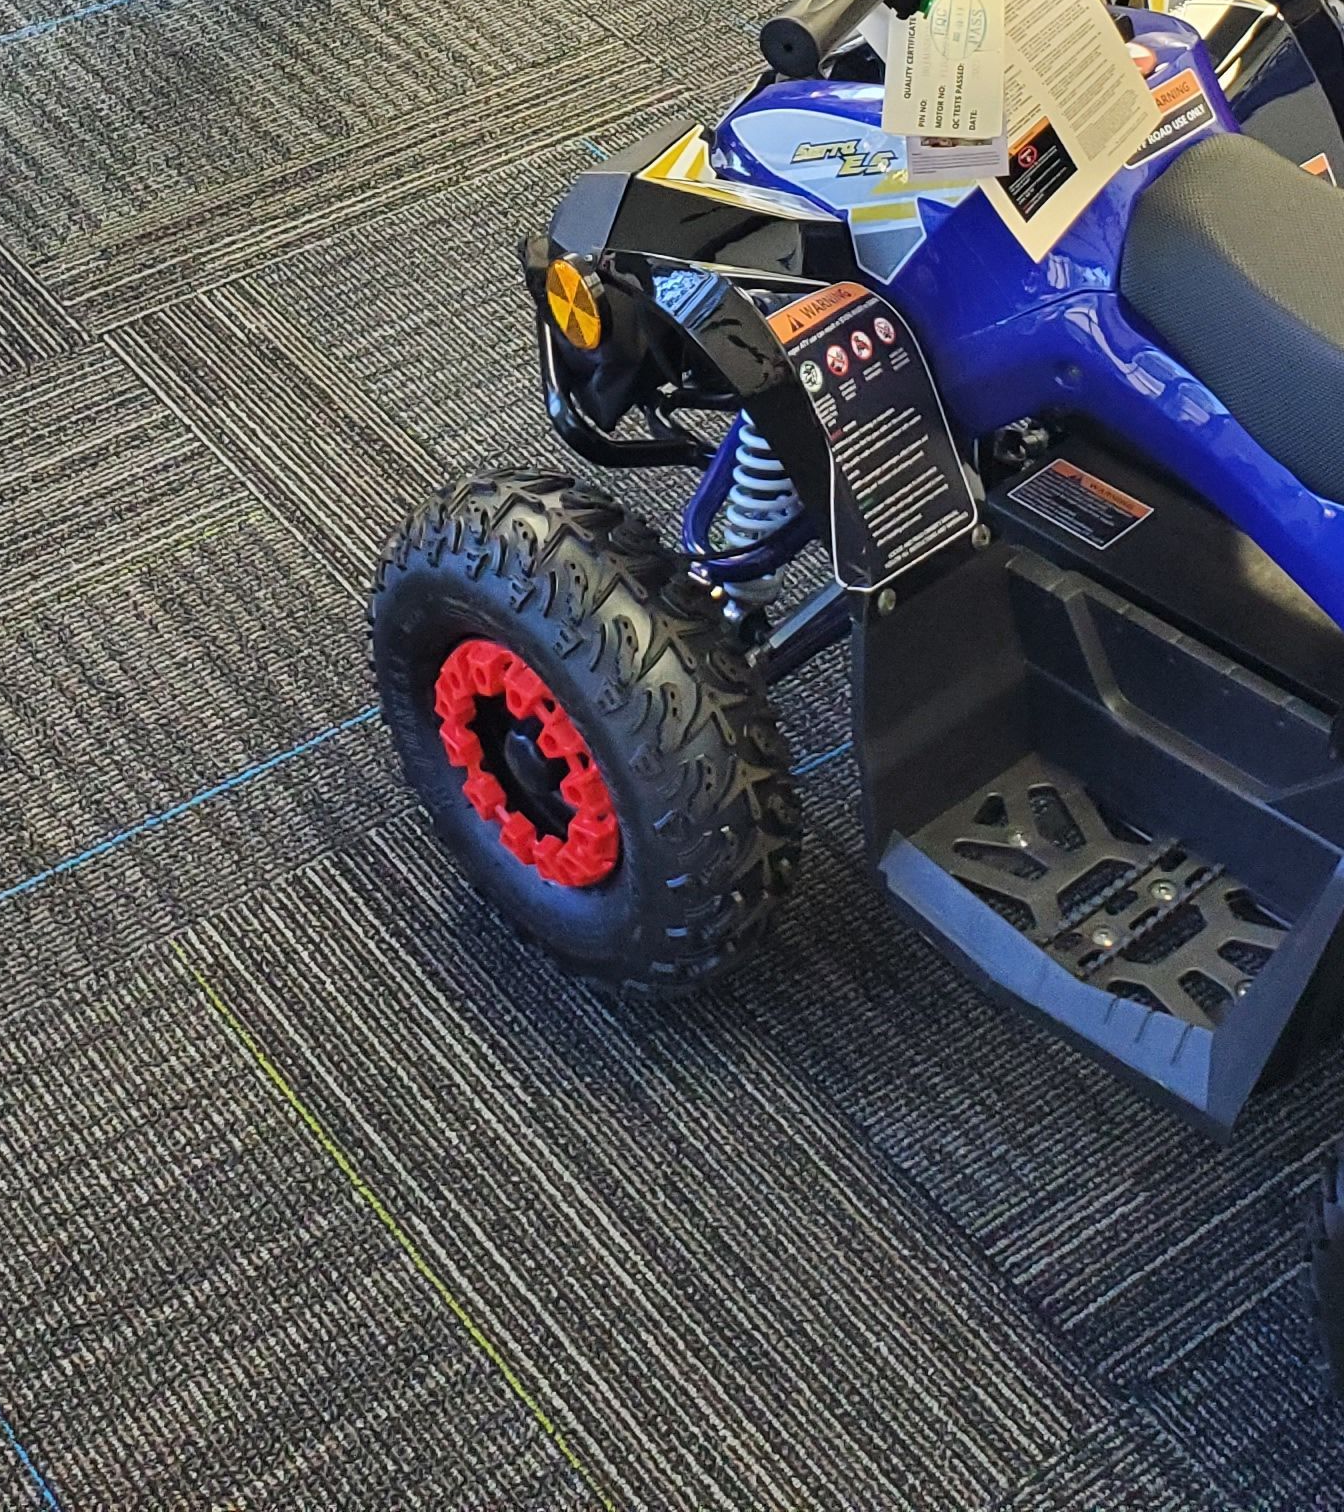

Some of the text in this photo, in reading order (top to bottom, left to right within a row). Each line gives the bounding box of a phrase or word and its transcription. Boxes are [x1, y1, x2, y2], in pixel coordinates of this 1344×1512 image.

[904, 17, 917, 99] QUALITY CERTIFICATE
[953, 95, 962, 118] TESTS
[1155, 81, 1190, 107] ARNING
[935, 99, 944, 129] MOTOR
[969, 110, 978, 131] DATE:
[1147, 124, 1173, 145] ROAD
[1171, 115, 1189, 130] USE
[1186, 104, 1205, 121] ONLY
[799, 288, 852, 320] WARNING
